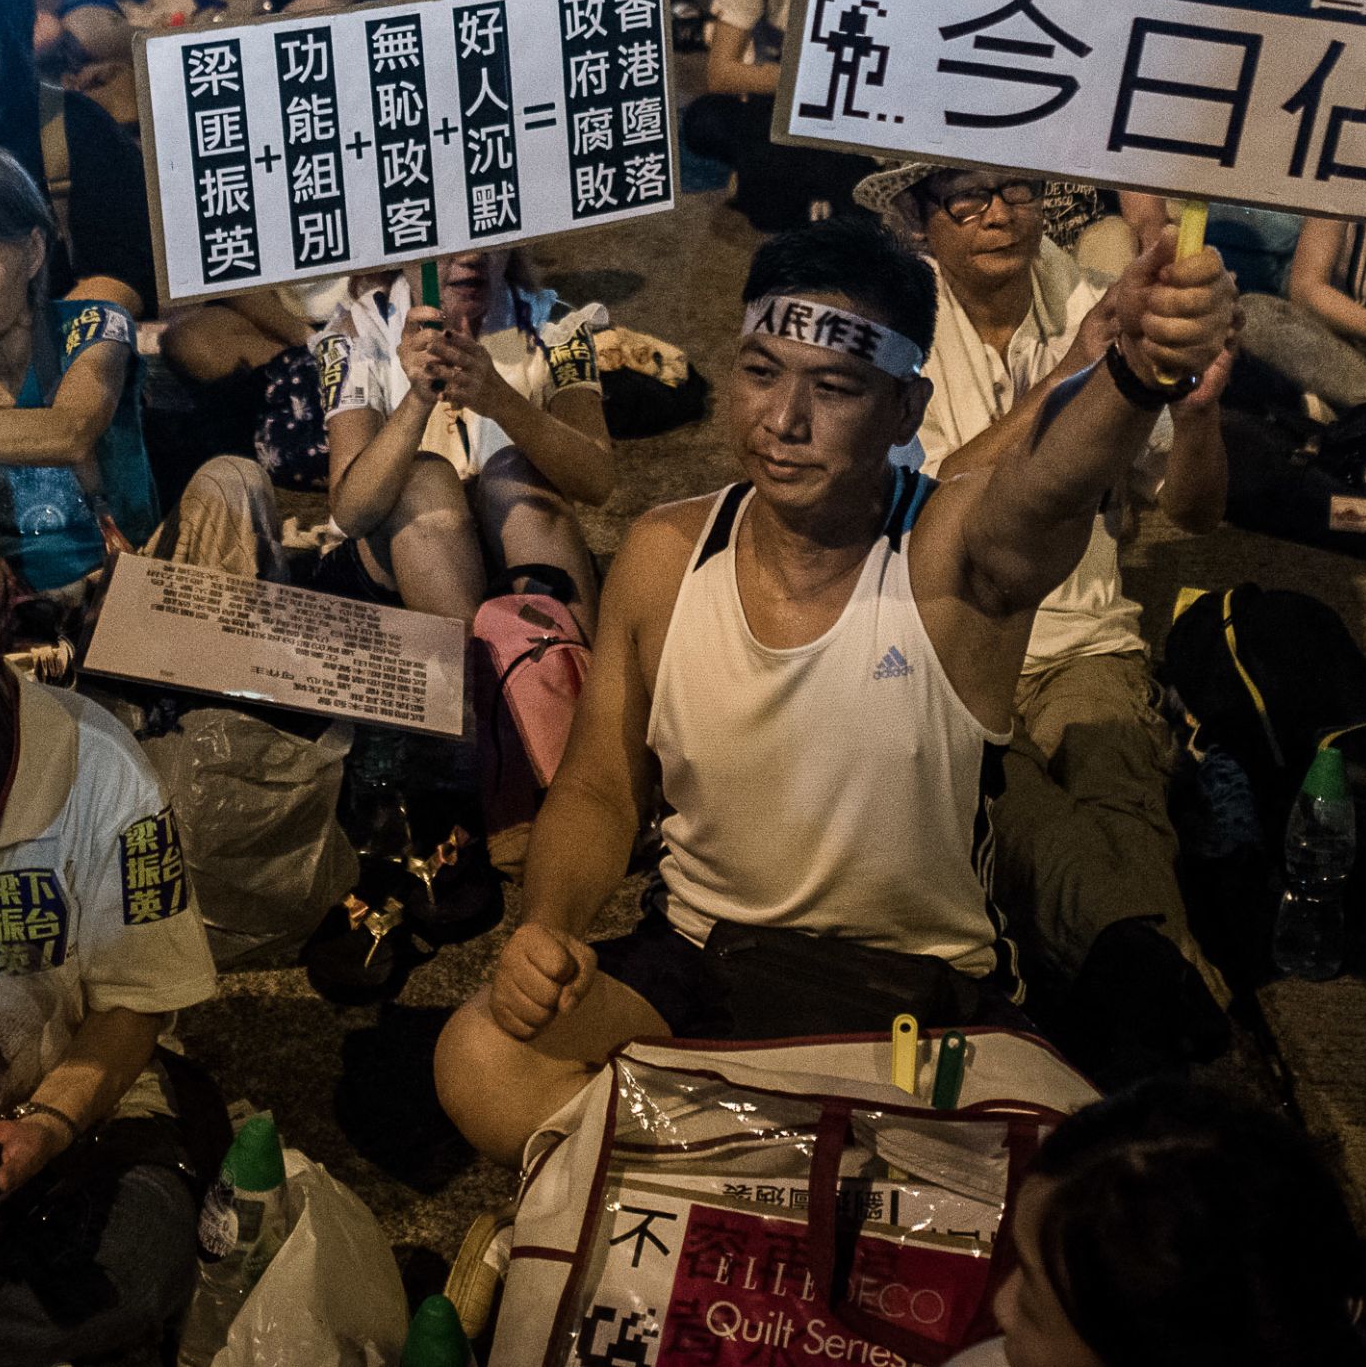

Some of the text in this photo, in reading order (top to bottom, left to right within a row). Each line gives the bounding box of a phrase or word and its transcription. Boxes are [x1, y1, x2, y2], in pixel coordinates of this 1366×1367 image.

[187, 44, 257, 278] 梁匪振英
[280, 34, 345, 263] 功能組別
[371, 23, 433, 248] 無恥政客
[458, 6, 518, 234] 好人沉默
[752, 298, 882, 362] 人民作主
[126, 819, 162, 925] 梁振英
[706, 1300, 795, 1350] Quilt
[713, 1252, 816, 1303] ELLE
